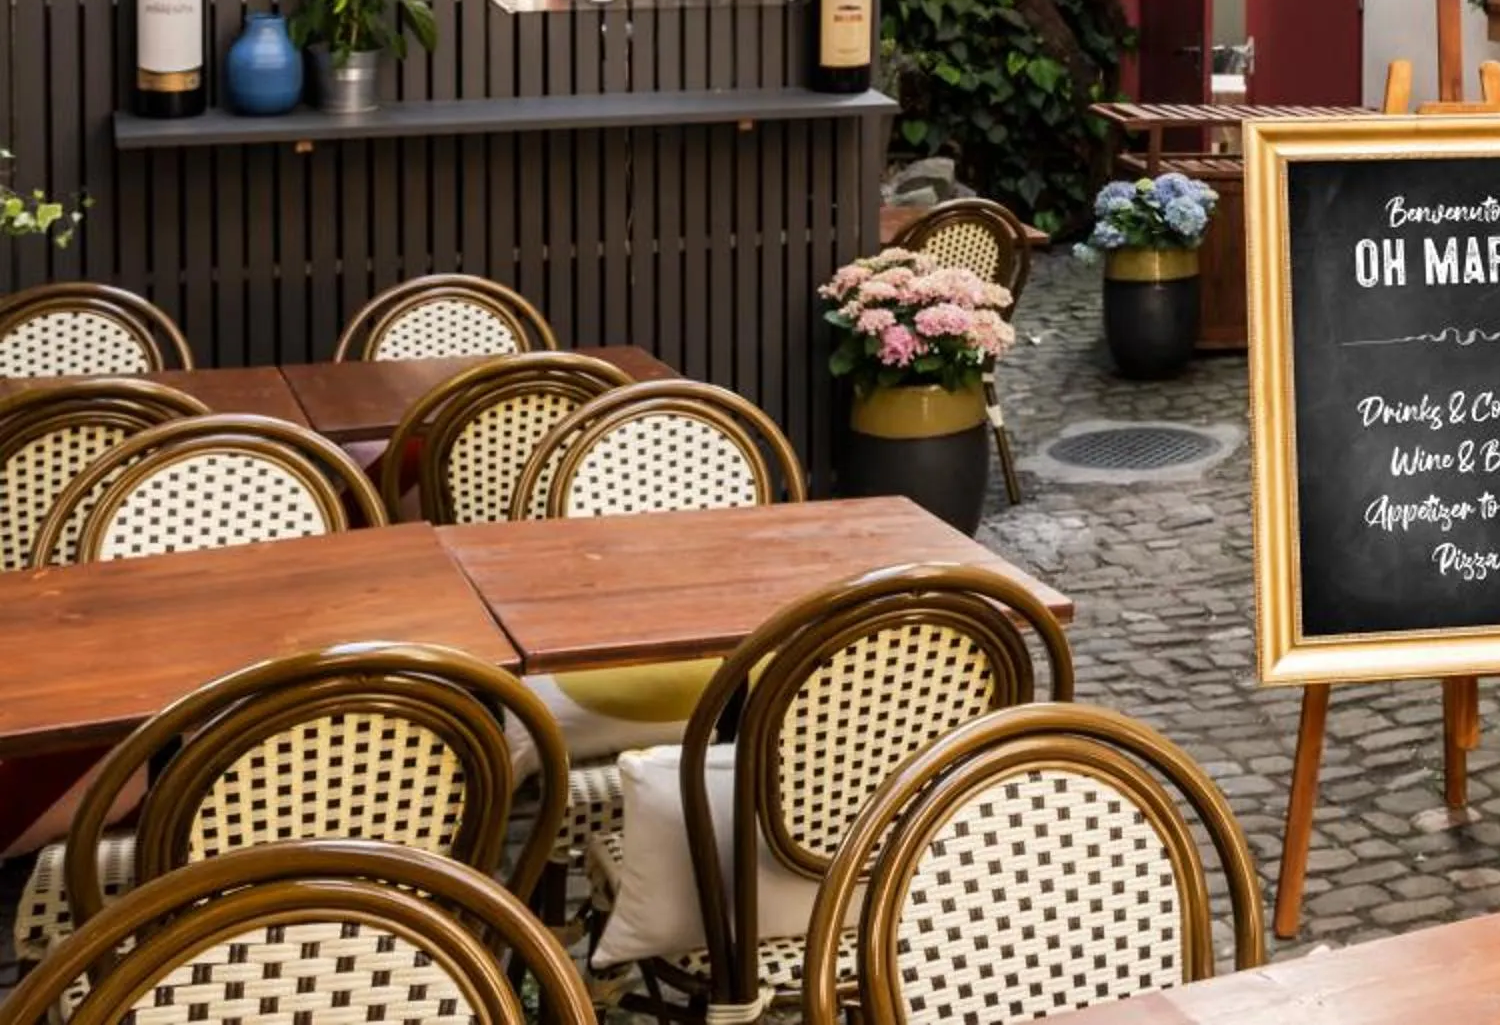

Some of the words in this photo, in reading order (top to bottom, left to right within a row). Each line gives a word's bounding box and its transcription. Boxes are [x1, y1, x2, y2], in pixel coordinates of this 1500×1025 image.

[1355, 238, 1407, 288] OH
[1357, 393, 1444, 431] Drinks
[1448, 391, 1467, 425] &
[1390, 446, 1455, 477] Wine
[1458, 440, 1476, 474] &
[1364, 493, 1476, 532] Appetizer
